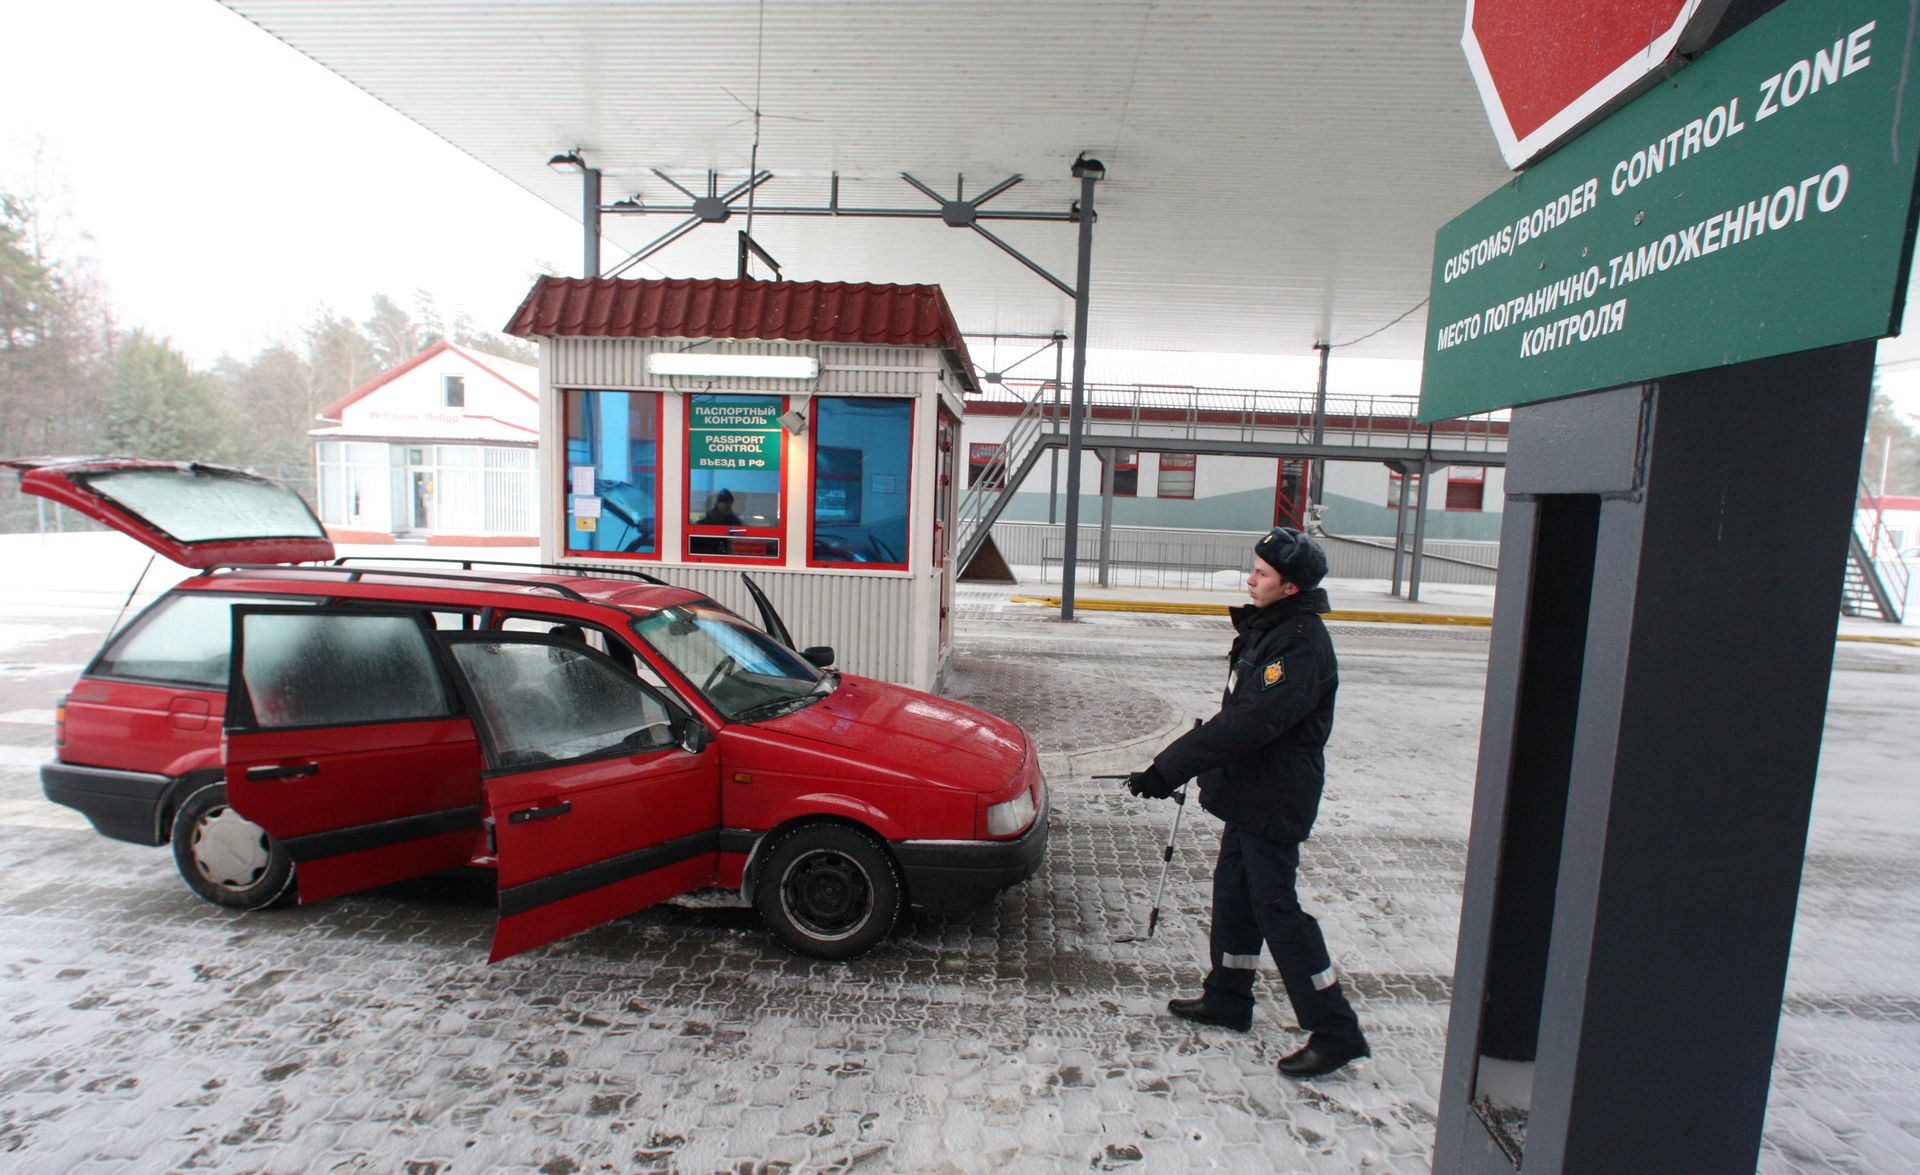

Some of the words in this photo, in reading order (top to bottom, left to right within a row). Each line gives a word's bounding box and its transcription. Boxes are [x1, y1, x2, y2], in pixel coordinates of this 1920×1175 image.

[1444, 178, 1598, 283] CUSTOMS/BORDER
[1611, 97, 1744, 196] CONTROL
[1755, 20, 1876, 122] ZONE
[1438, 313, 1480, 351] МЕСТО
[1484, 164, 1849, 333] ПОГРАНИЧНО-ТАМОЖЕННОГО
[1520, 299, 1627, 358] КОНТРОЛЯ
[695, 406, 776, 415] ПАСПОРТНЫЙ
[704, 416, 767, 424] КОНТРОЛЬ
[705, 435, 765, 443] PASSPORT
[708, 444, 762, 452] CONTROL
[700, 459, 736, 467] ВЪЕЗД
[738, 459, 746, 467] В
[748, 459, 765, 467] РФ
